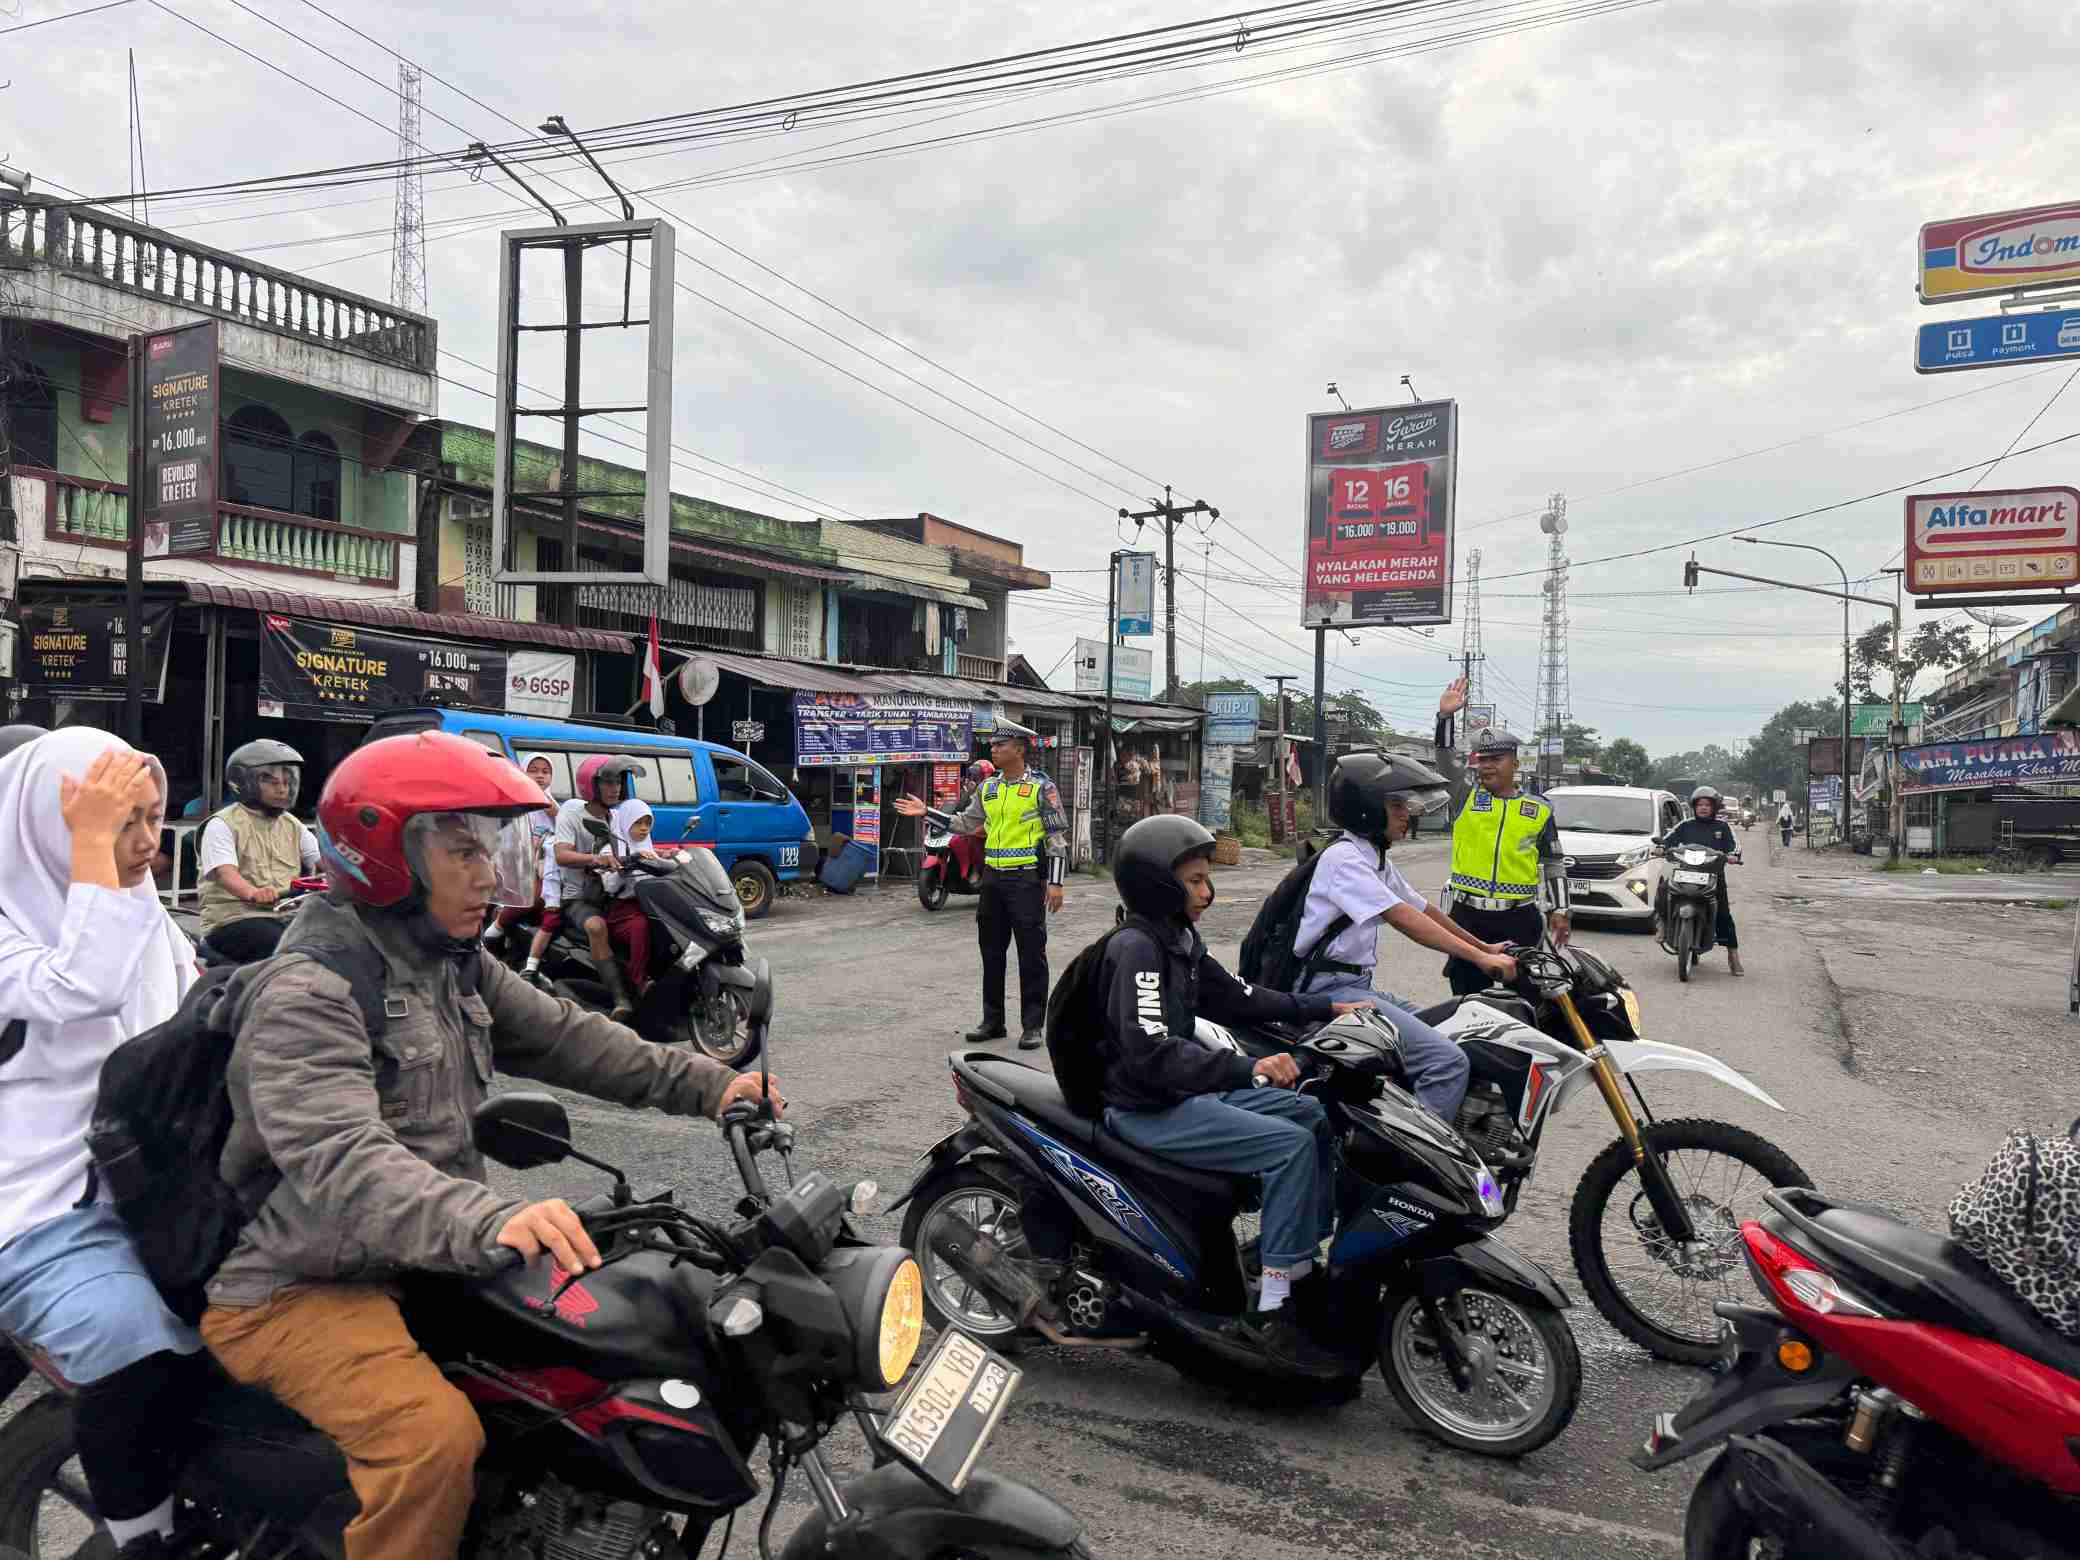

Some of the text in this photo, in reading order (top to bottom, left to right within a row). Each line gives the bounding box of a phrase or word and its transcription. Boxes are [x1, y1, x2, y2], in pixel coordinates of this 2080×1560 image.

[151, 374, 209, 399] SIGNATURE
[162, 394, 199, 411] KRETEK
[161, 427, 195, 452] 16.000
[1386, 439, 1437, 451] MERAH
[162, 463, 197, 484] REVOLUSI
[162, 481, 197, 502] KRETEK
[1344, 475, 1410, 503] 12 16
[1925, 500, 2067, 530] Alfamart
[1344, 520, 1417, 538] 16.000 19.000
[1316, 555, 1438, 573] NYALAKAN MERAH
[1316, 569, 1436, 585] YANG MELEGENDA
[33, 634, 87, 650] SIGNATURE
[41, 653, 76, 667] KRETEK
[296, 650, 387, 677] SIGNATURE
[428, 649, 468, 670] 16.000
[312, 673, 369, 691] KRETEK
[529, 676, 570, 697] GGSP
[1964, 742, 2046, 765] PUTRA
[1946, 767, 2013, 782] Masakan
[2016, 762, 2055, 776] Khas
[1388, 1196, 1436, 1221] HONDA
